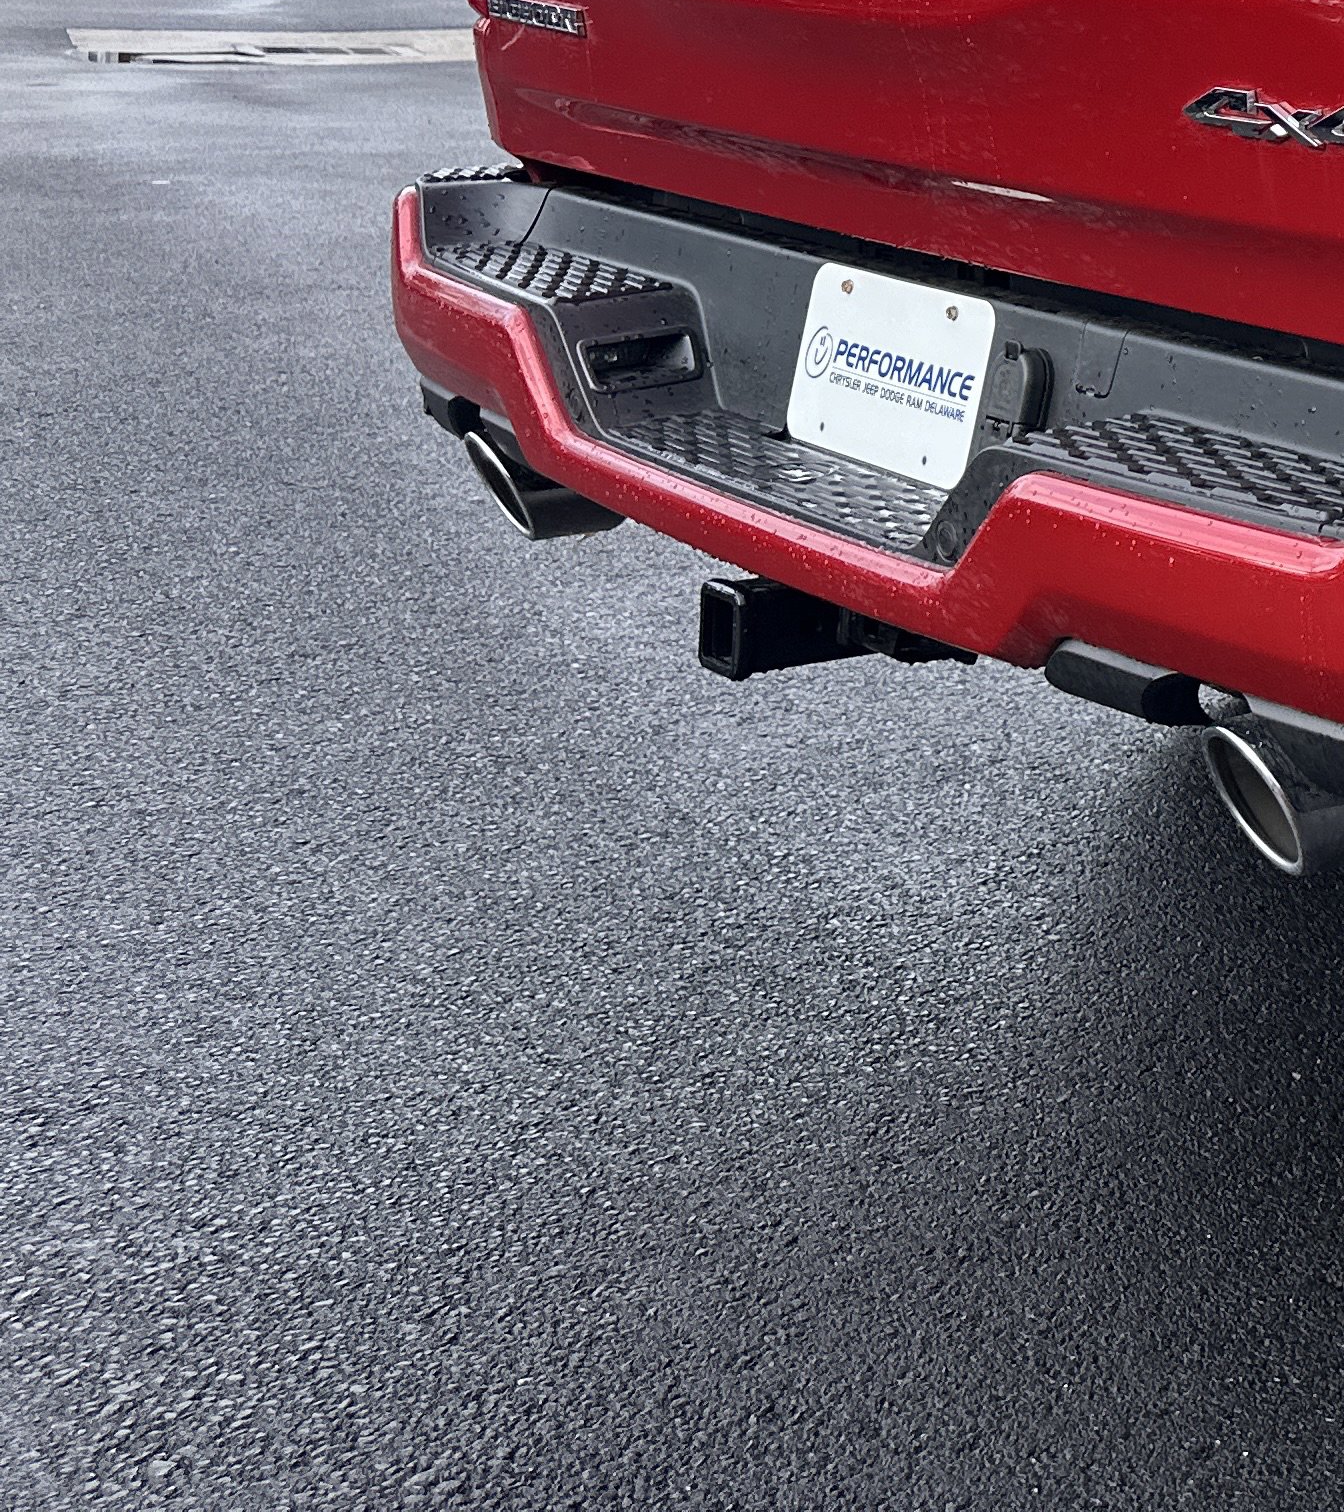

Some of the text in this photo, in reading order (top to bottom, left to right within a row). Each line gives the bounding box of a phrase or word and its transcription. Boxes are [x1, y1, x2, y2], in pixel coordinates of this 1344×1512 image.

[829, 371, 966, 423] CHRYSLER JEEP DODGE RAM DELAWARE
[833, 338, 976, 401] PERFORMANCE
